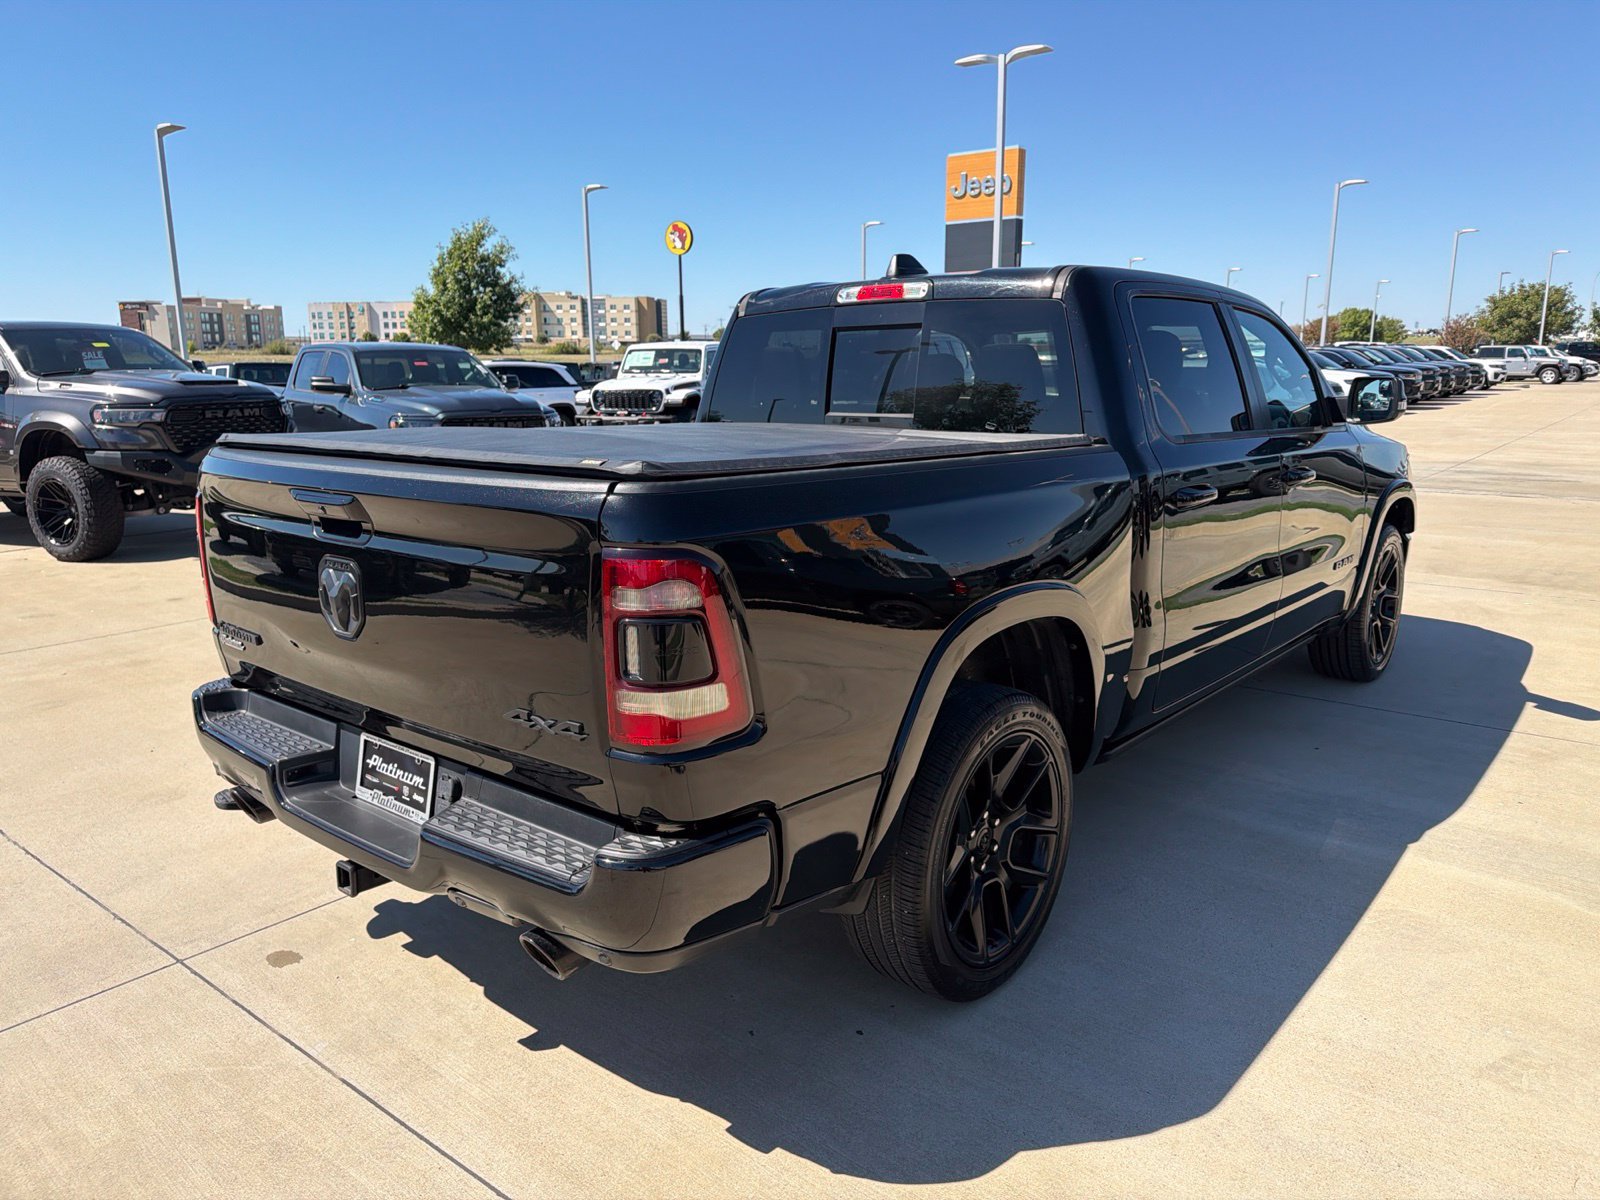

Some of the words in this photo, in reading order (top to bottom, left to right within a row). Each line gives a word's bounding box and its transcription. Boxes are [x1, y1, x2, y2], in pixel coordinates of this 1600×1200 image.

[81, 351, 104, 360] SALE
[204, 407, 260, 419] RAM
[979, 712, 1019, 749] EAGLE
[1021, 711, 1061, 740] TOURING
[365, 754, 427, 790] Platinum
[370, 790, 414, 819] Platinum
